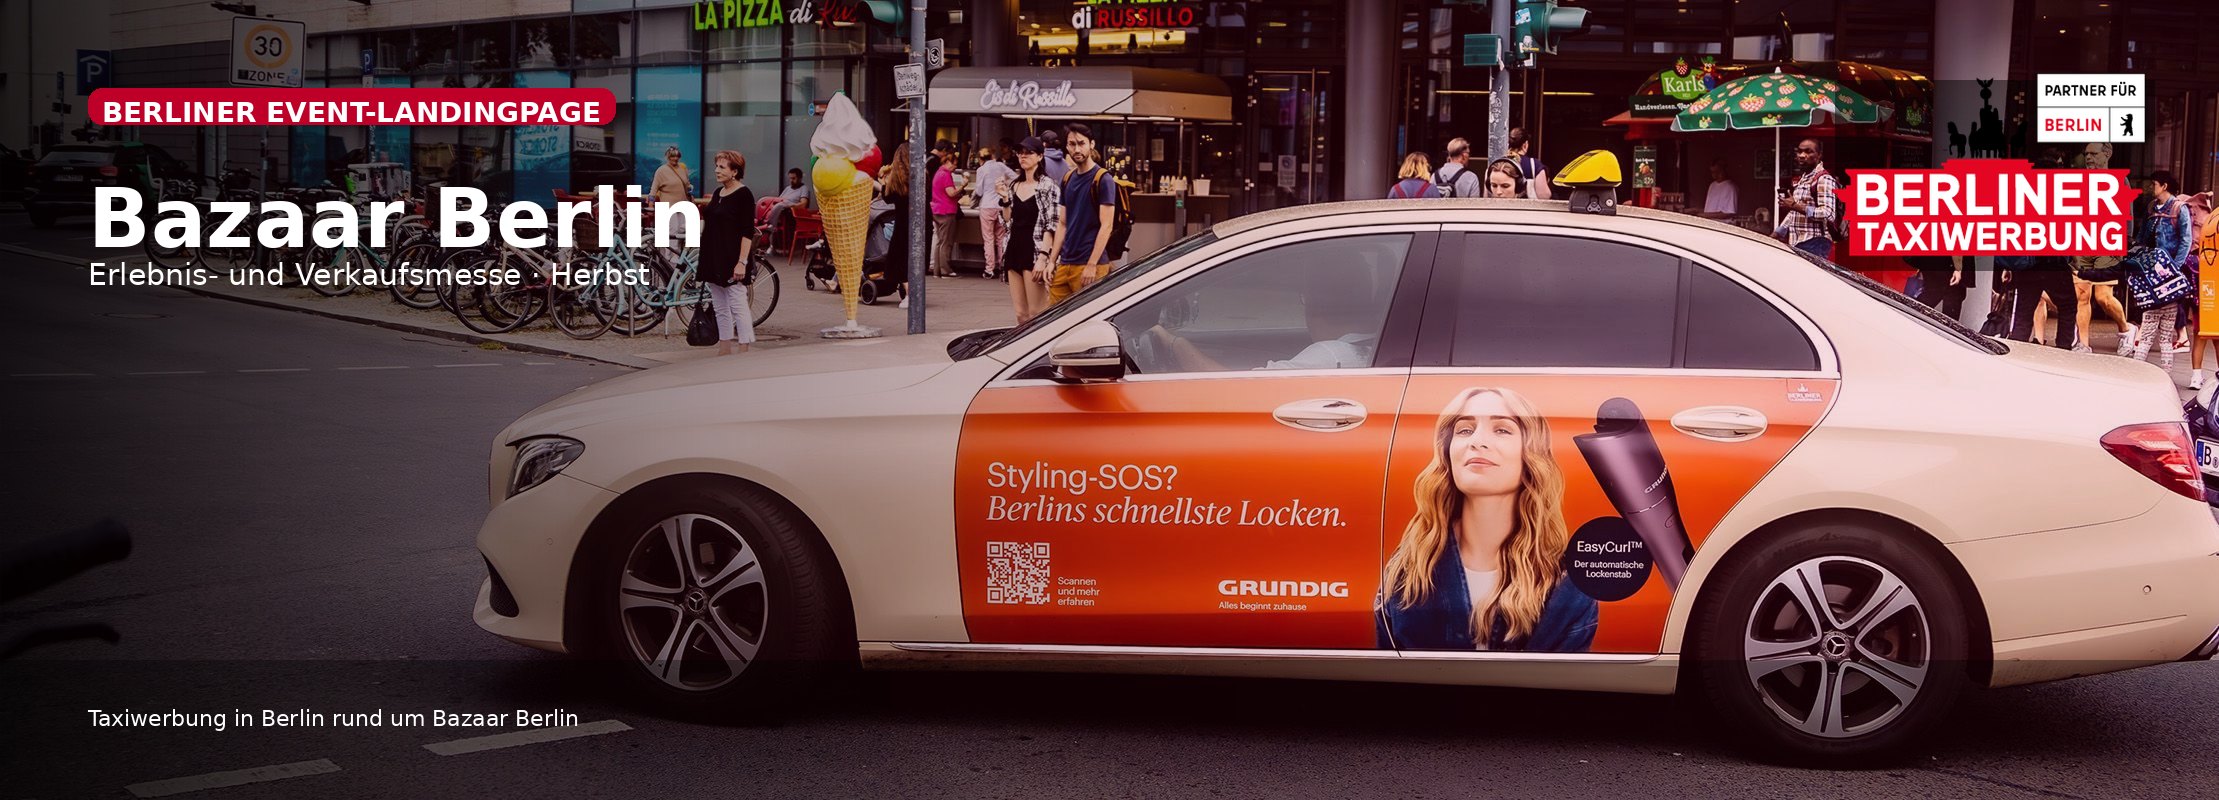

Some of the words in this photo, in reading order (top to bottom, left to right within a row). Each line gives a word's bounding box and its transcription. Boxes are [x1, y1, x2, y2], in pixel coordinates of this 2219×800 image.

[692, 1, 718, 30] LA
[723, 0, 784, 29] PIZZA
[789, 0, 813, 24] di
[1071, 6, 1091, 29] di
[1097, 7, 1194, 29] RUSSILLO
[254, 36, 283, 57] 30
[86, 62, 102, 83] P
[1664, 75, 1706, 93] Karls
[1019, 80, 1076, 110] Russillo
[2204, 445, 2212, 466] B
[988, 461, 1178, 495] Styling-SOS?
[986, 495, 1087, 523] Berlins
[1092, 496, 1233, 526] schnellste
[1238, 500, 1347, 527] Locken.
[1577, 540, 1643, 555] EasyCurl™
[1574, 560, 1588, 569] Der
[1589, 560, 1645, 570] automatische
[1586, 570, 1632, 579] Lockenstab
[1057, 577, 1097, 586] Scannen
[1218, 579, 1349, 598] GRUNDIG
[1057, 587, 1074, 596] und
[1076, 588, 1100, 596] mehr
[1057, 597, 1095, 606] erfahren
[1218, 601, 1239, 610] Alles
[1241, 602, 1270, 613] beginnt
[1273, 603, 1307, 611] zuhause
